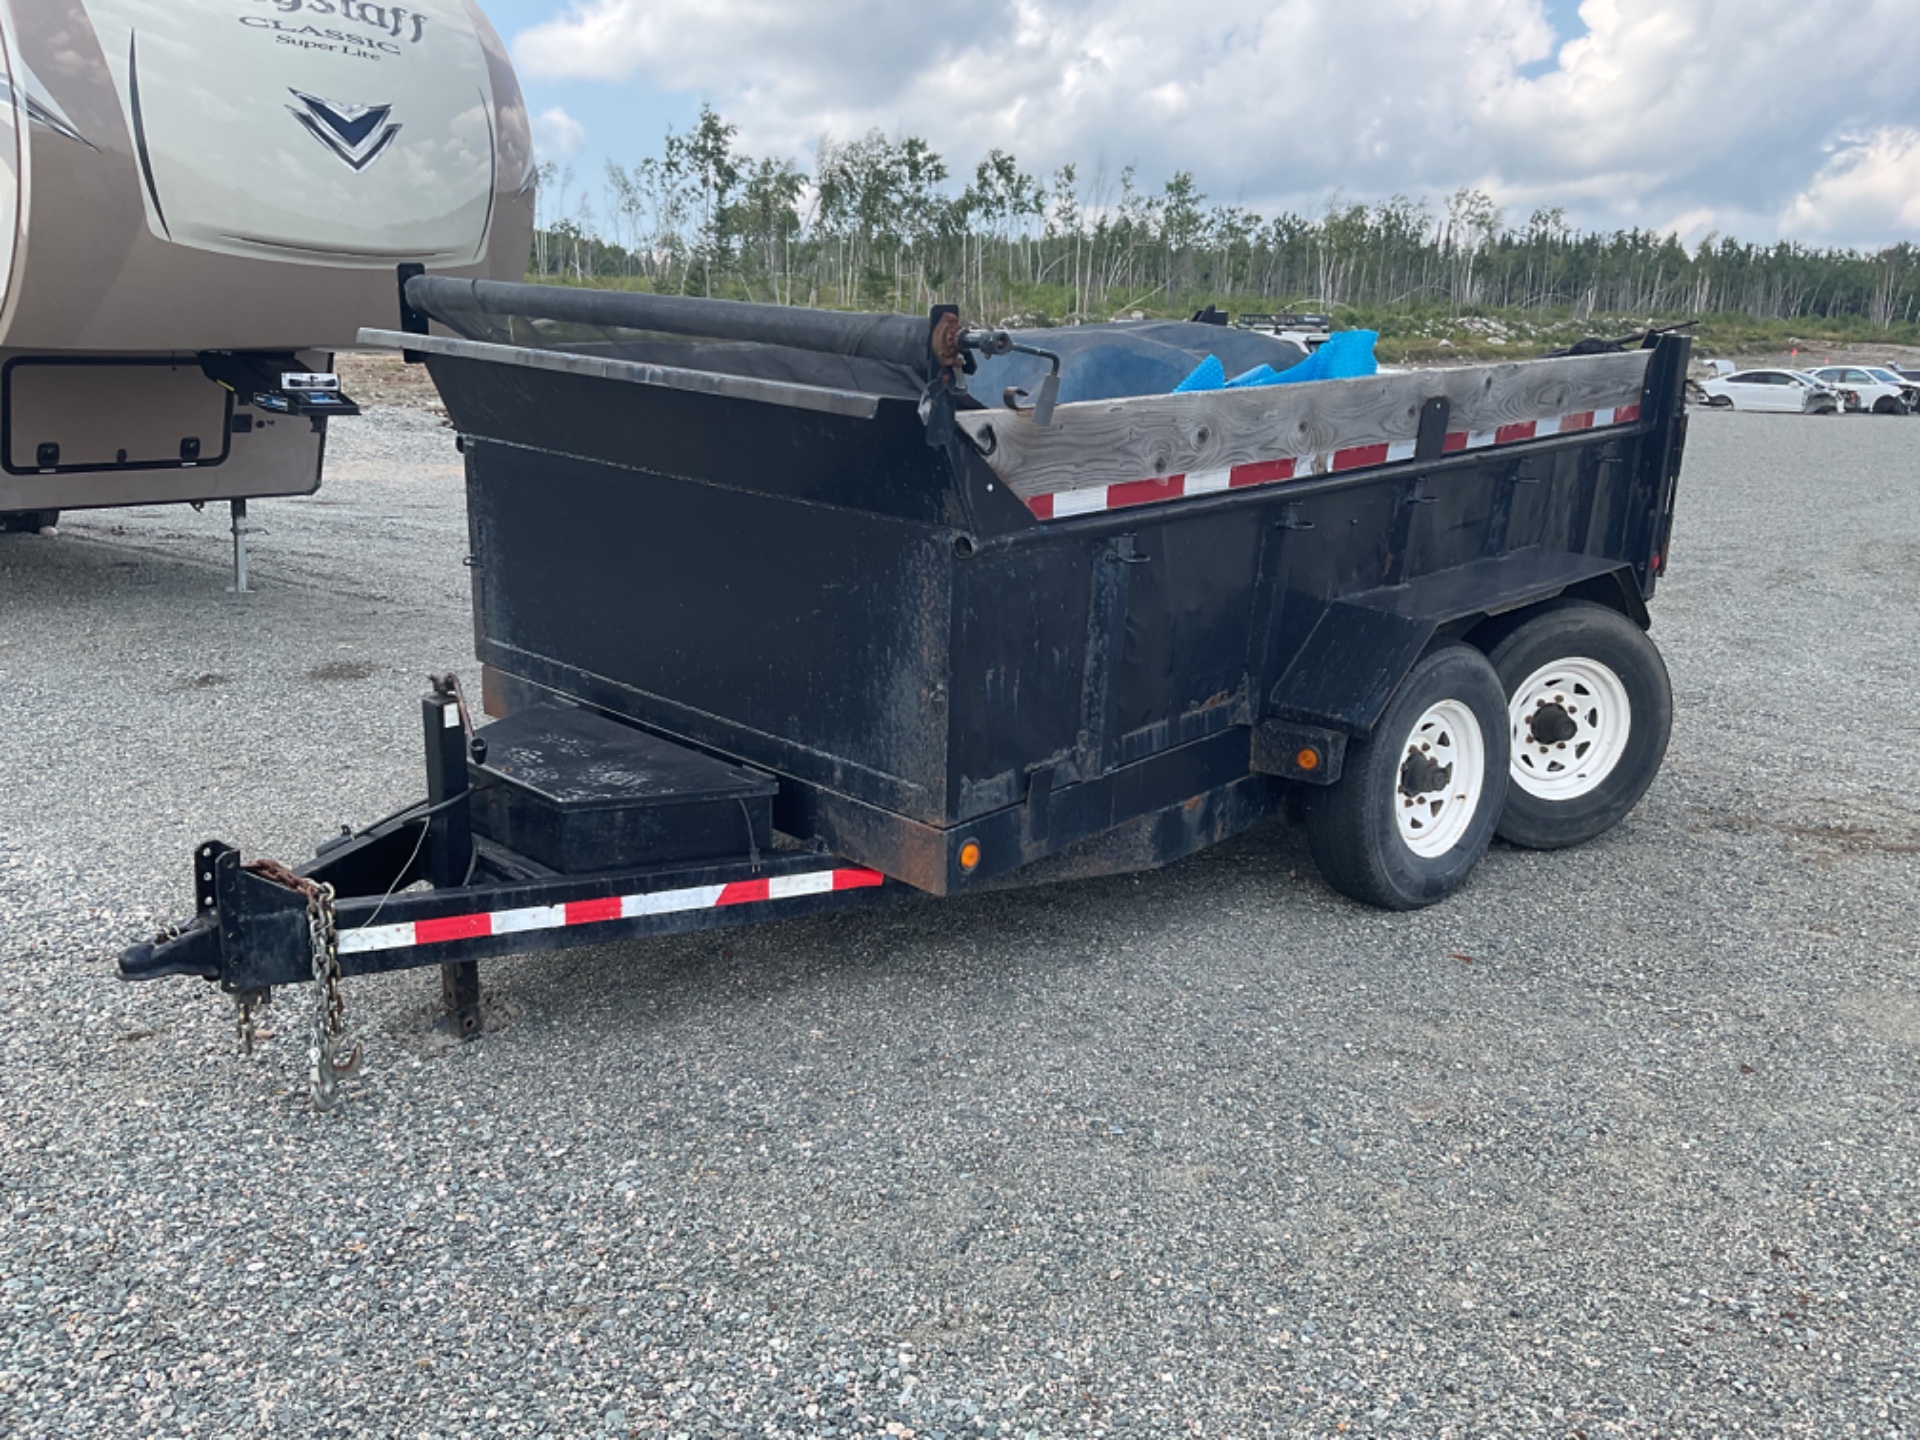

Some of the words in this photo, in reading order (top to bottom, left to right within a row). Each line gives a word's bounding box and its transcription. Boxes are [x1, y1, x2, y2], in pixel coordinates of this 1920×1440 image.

[238, 16, 401, 55] CLASSIC
[275, 34, 338, 51] Super
[342, 45, 381, 61] Lite
